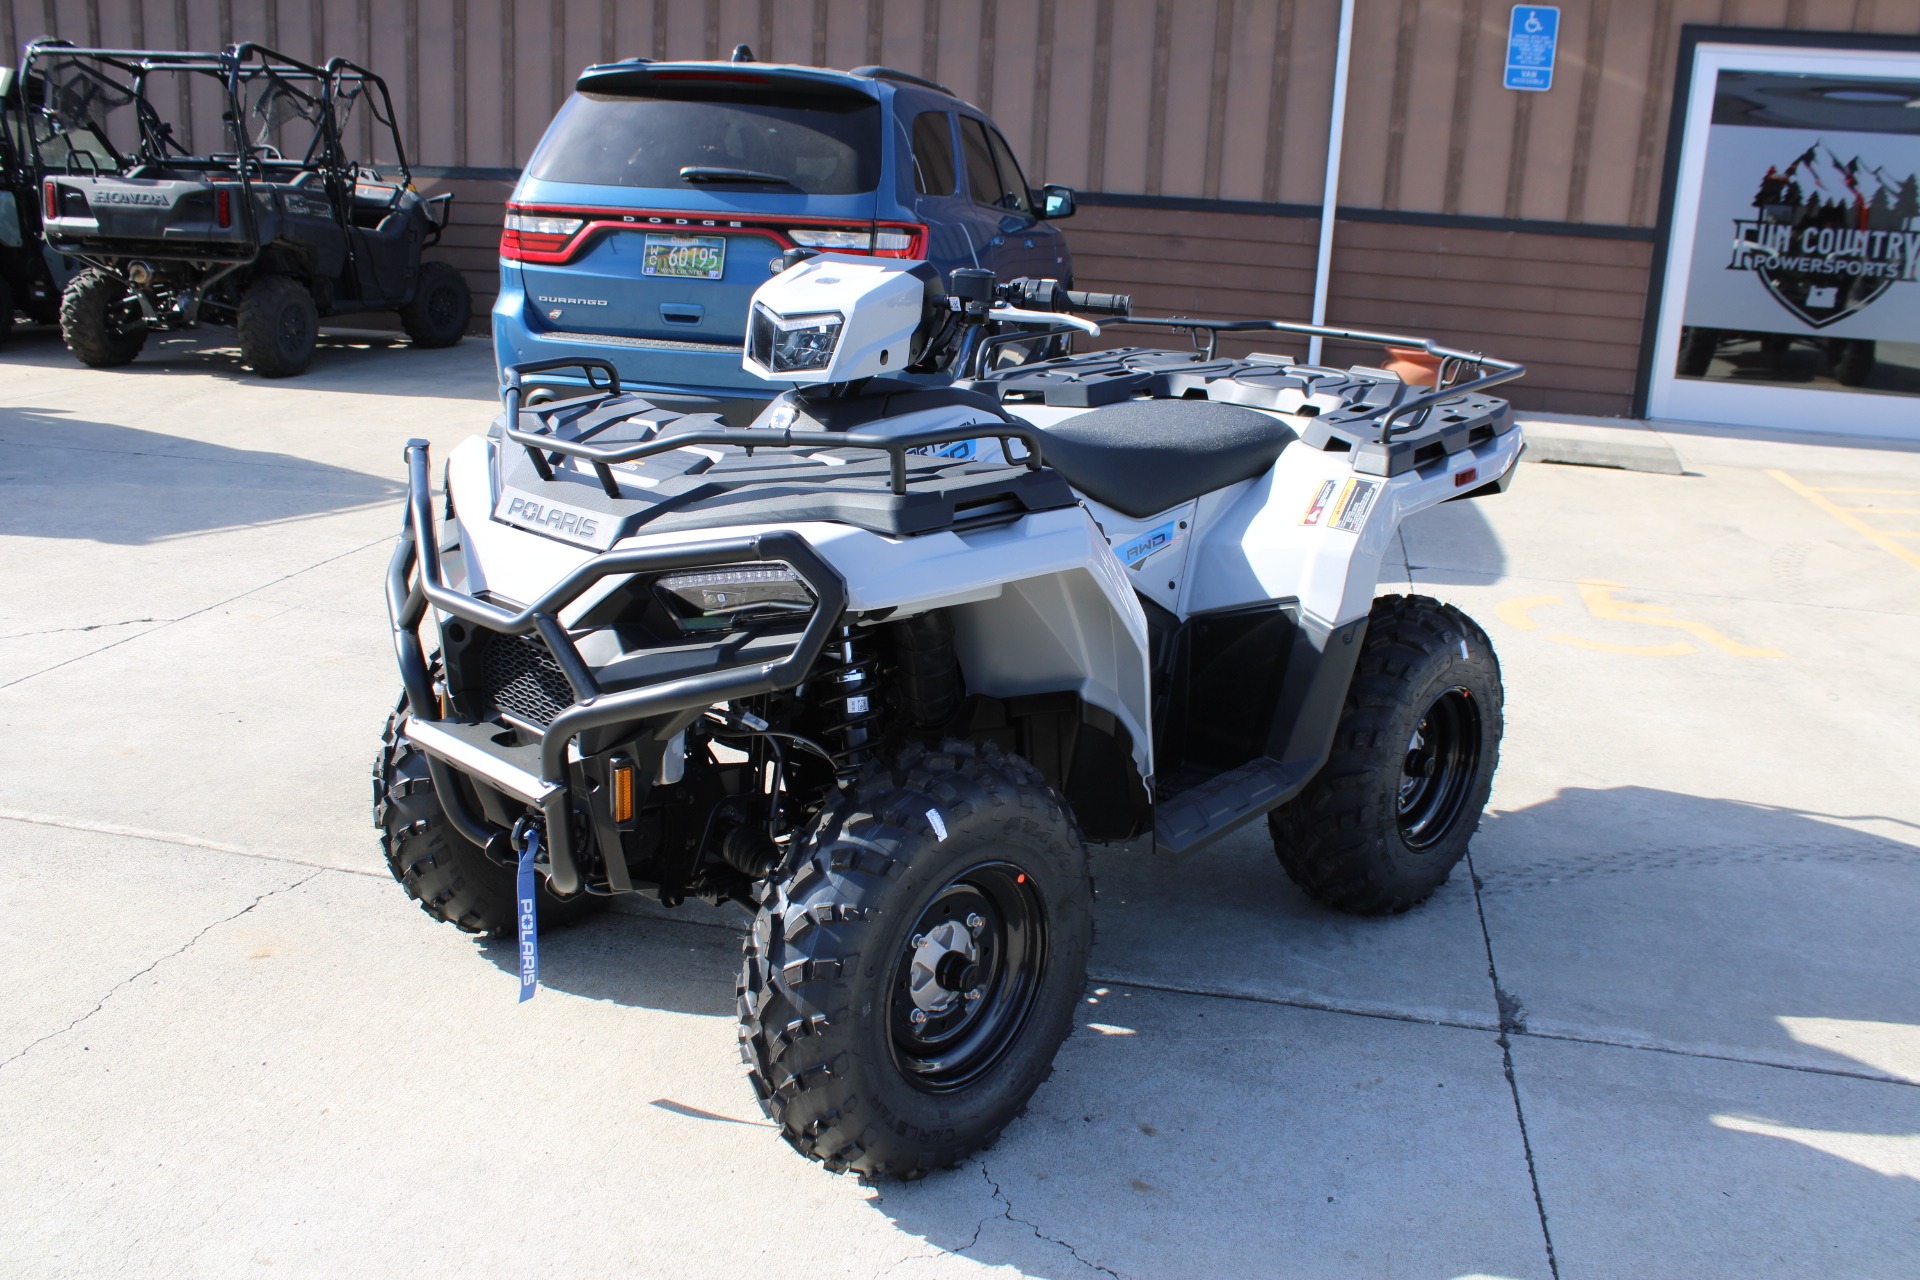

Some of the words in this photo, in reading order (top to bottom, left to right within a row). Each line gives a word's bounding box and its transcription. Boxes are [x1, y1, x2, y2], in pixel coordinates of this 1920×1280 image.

[94, 191, 170, 206] HONDA
[623, 215, 742, 228] DODGE
[668, 246, 719, 269] 60195
[1730, 219, 1793, 270] FUN
[1801, 226, 1920, 281] COUNTRY
[676, 268, 704, 276] COUNTRY
[1753, 253, 1899, 279] POWERSPORTS
[538, 295, 608, 306] DURANGO
[508, 497, 599, 537] POLARIS
[1126, 533, 1166, 561] AWD
[520, 898, 535, 986] POLARIS
